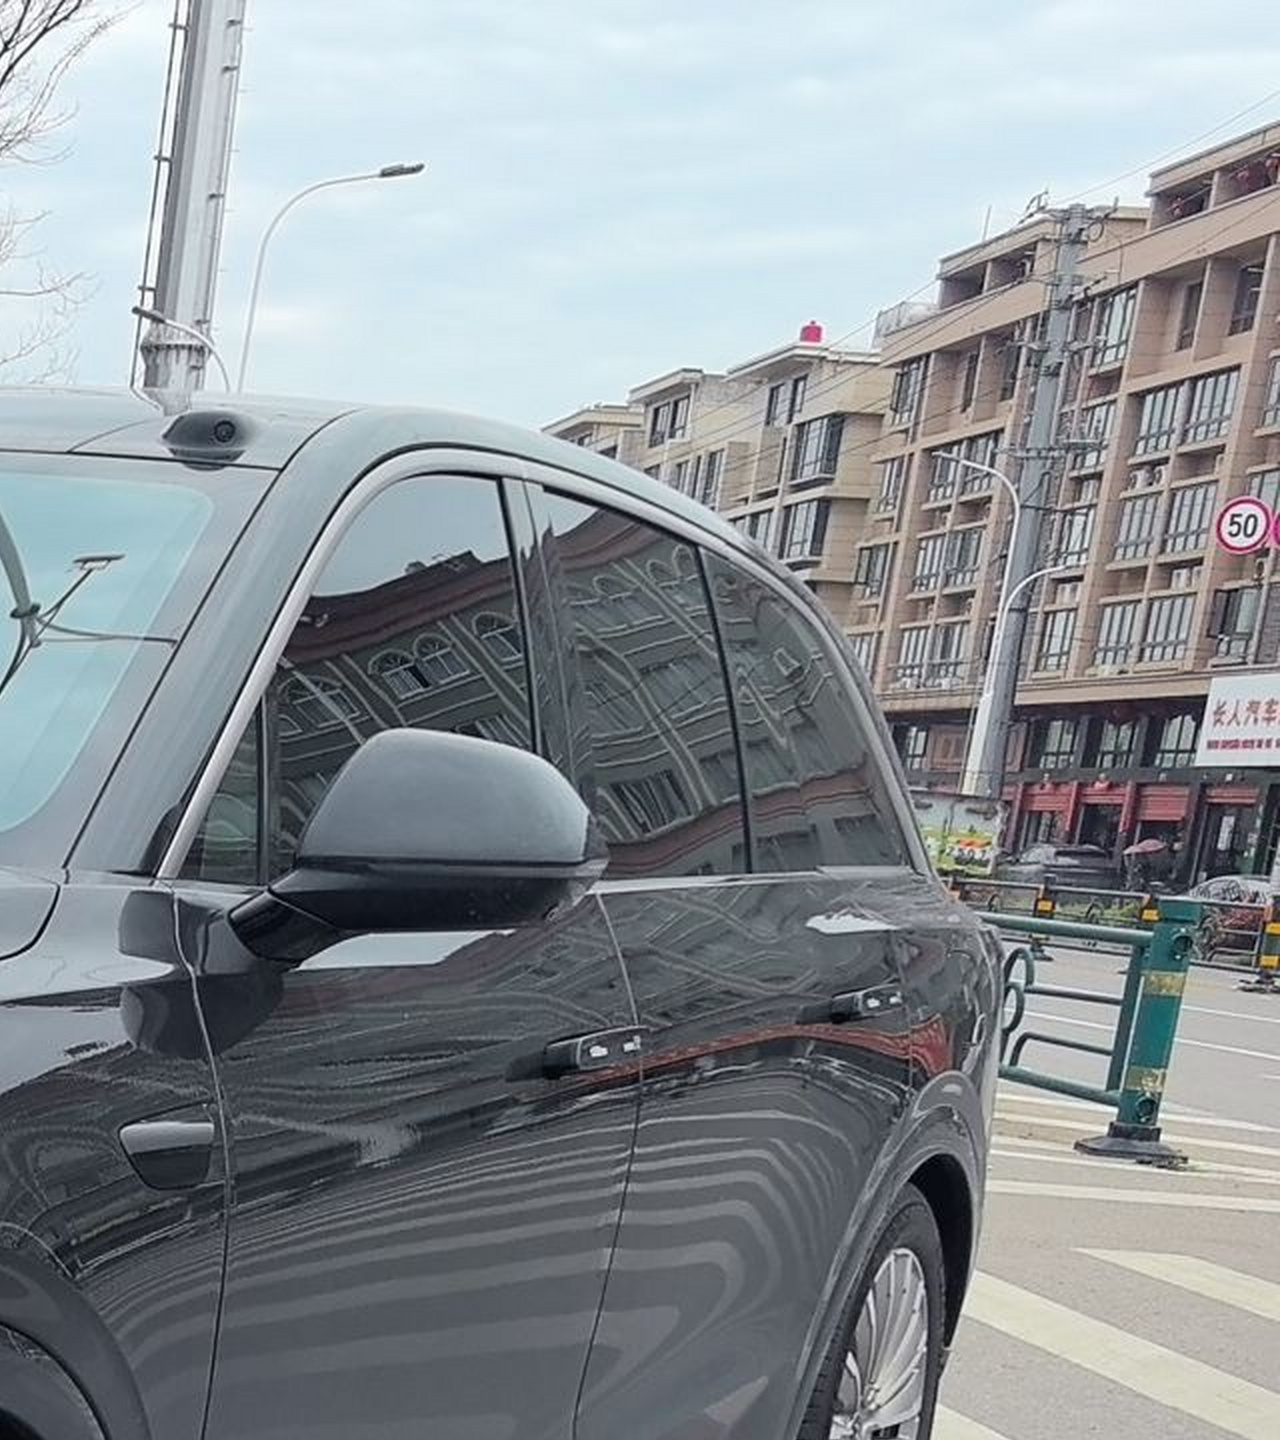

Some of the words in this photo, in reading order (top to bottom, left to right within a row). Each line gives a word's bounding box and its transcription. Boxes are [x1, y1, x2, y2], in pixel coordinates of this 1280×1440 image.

[1228, 513, 1259, 538] 50
[1213, 698, 1280, 727] 长人汽车
